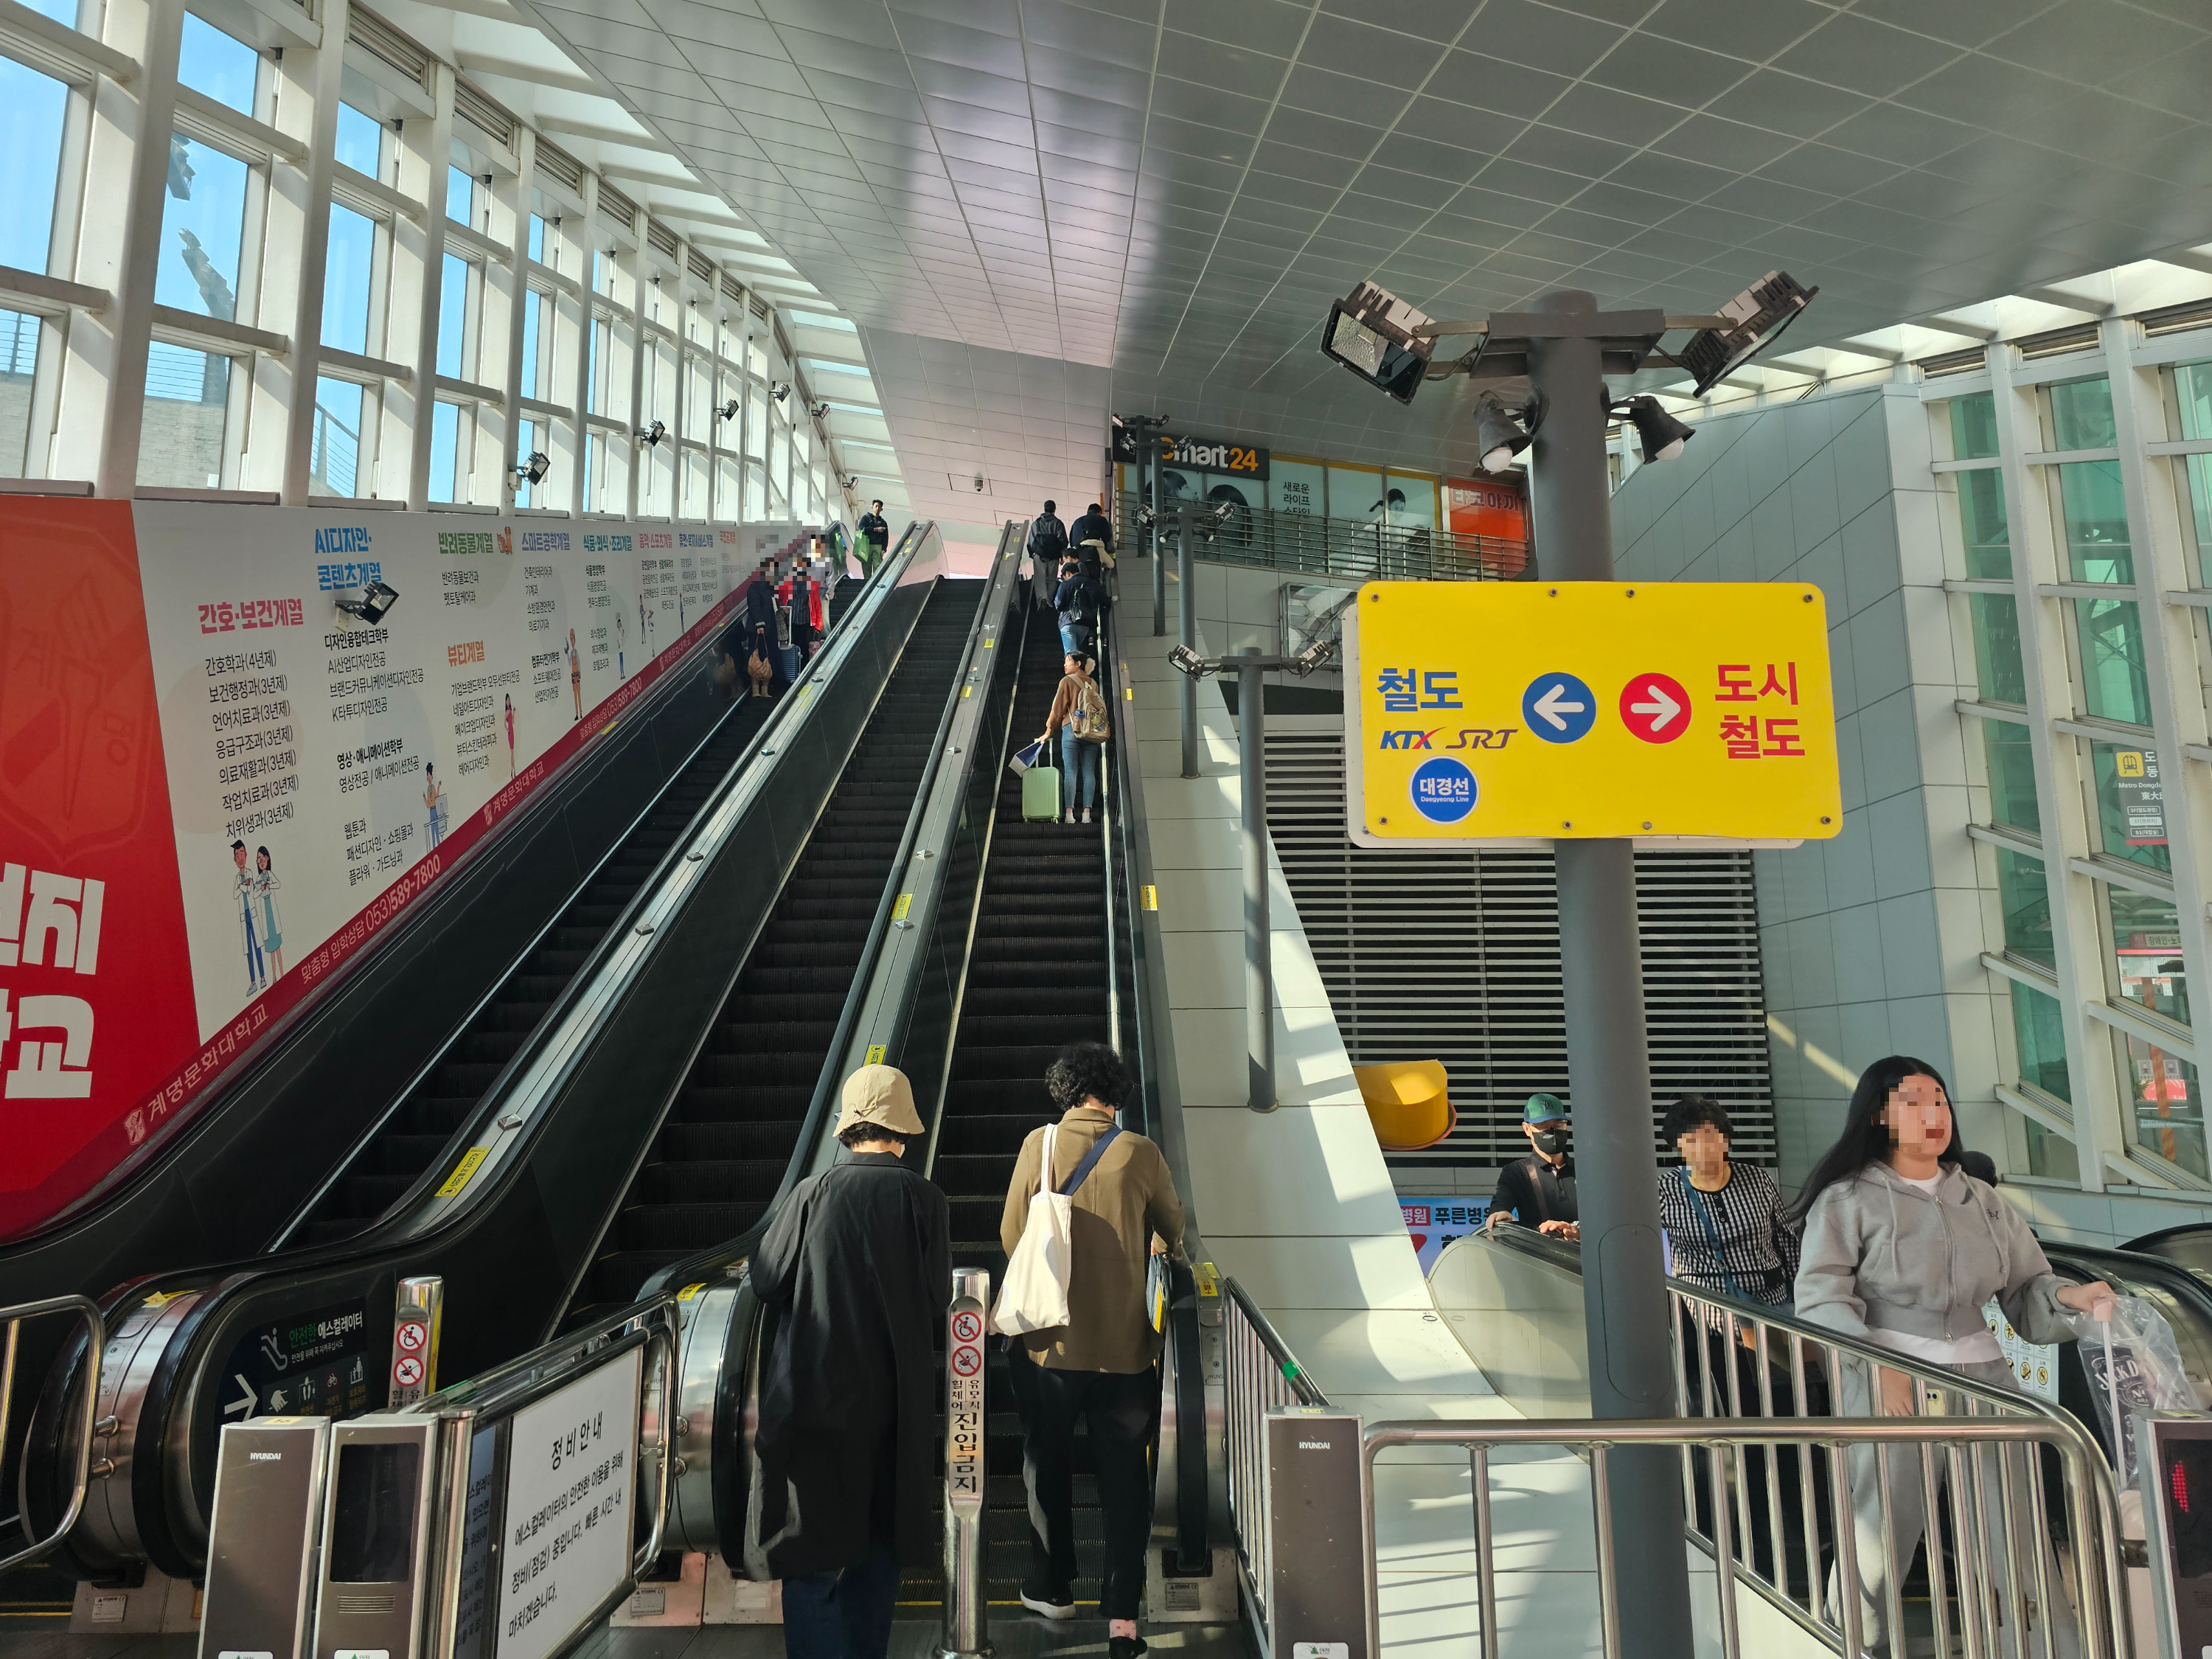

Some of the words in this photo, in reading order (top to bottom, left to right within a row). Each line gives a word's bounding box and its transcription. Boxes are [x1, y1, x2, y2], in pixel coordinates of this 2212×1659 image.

[1283, 481, 1310, 494] 새로운
[1284, 494, 1310, 506] 라이프
[1451, 487, 1519, 512] 타코야끼
[438, 532, 493, 554] 반려동물계열
[522, 532, 571, 552] 스마트공학계열
[317, 562, 381, 591] 콘텐츠계열
[442, 570, 479, 585] 반려동물보건과
[524, 566, 553, 579] 건축인테리어과
[444, 590, 476, 606] 펫토탈케어과
[526, 584, 539, 597] 기계과
[198, 598, 304, 634] 간호·보건계열
[527, 600, 556, 614] 소방환경안전과
[529, 618, 549, 632] 의료기기과
[324, 628, 389, 651] 디자인융합테크학부
[205, 649, 277, 677] 간호학과(4년제)
[327, 651, 386, 674] AI산업디자인전공
[448, 641, 484, 667] 뷰티계열
[532, 651, 560, 668] 컴퓨터전기학부
[209, 674, 288, 703] 보건행정과(3년제)
[330, 668, 424, 698] 브랜드커뮤니케이션디자인전공
[451, 677, 487, 696] 기업브랜드학부
[488, 669, 520, 687] 오무선뷰티전공
[533, 668, 561, 684] 소프트웨어전공
[1715, 662, 1798, 705] 도시
[535, 686, 559, 703] 산업전기전공
[1377, 668, 1463, 712] 철도
[212, 700, 291, 731] 언어치료과(3년제)
[332, 697, 388, 723] K타투디자인전공
[453, 695, 494, 717] 네일아트디자인과
[455, 714, 495, 736] 메이크업디자인과
[1380, 726, 1448, 750] KTX
[1445, 729, 1519, 749] SRT
[1719, 714, 1805, 759] 철도
[216, 726, 293, 759] 응급구조과(3년제)
[337, 738, 403, 771] 영상·애니메이션학부
[456, 732, 497, 757] 뷰티스킨테라피과
[493, 761, 544, 815] 계명문화대학교
[607, 677, 641, 718] 053)589-7800
[219, 749, 296, 785] 의료재활과(3년제)
[459, 755, 489, 776] 헤어디자인과
[2145, 751, 2158, 762] 도
[339, 769, 369, 793] 영상전공
[375, 756, 420, 782] 애니메이션전공
[1419, 778, 1470, 796] 대경선
[222, 774, 299, 812] 작업치료과(3년제)
[226, 801, 293, 838] 치위생과(3년제)
[344, 818, 366, 840] 웹툰과
[347, 835, 381, 861] 패션디자인
[388, 822, 413, 846] 쇼핑몰과
[349, 863, 370, 886] 플라워
[377, 849, 403, 872] 가드닝과
[147, 1004, 268, 1123] 계명문화대학교
[302, 949, 330, 984] 맞춤형
[331, 919, 365, 960] 입학상담
[366, 854, 440, 931] 053)589-7800
[0, 988, 94, 1099] 교
[289, 1323, 317, 1349] 안전한
[318, 1311, 363, 1339] 에스컬레이터
[291, 1351, 305, 1363] 안전을
[305, 1348, 314, 1358] 위해
[315, 1346, 319, 1355] 꼭
[2095, 1365, 2129, 1391] JCK
[952, 1380, 962, 1411] 휠체어
[953, 1412, 977, 1493] 진입금지
[1299, 1441, 1330, 1450] HYUNDAI
[515, 1490, 568, 1545] 에스컬레이터의
[570, 1475, 590, 1506] 안전한
[591, 1460, 610, 1488] 이용을
[611, 1450, 624, 1474] 위해
[512, 1544, 550, 1594] 정비(점검)
[552, 1520, 582, 1560] 중입니다.
[585, 1508, 598, 1531] 빠른
[600, 1495, 613, 1517] 시간
[615, 1486, 622, 1507] 내
[508, 1580, 557, 1638] 마치겠습니다.
